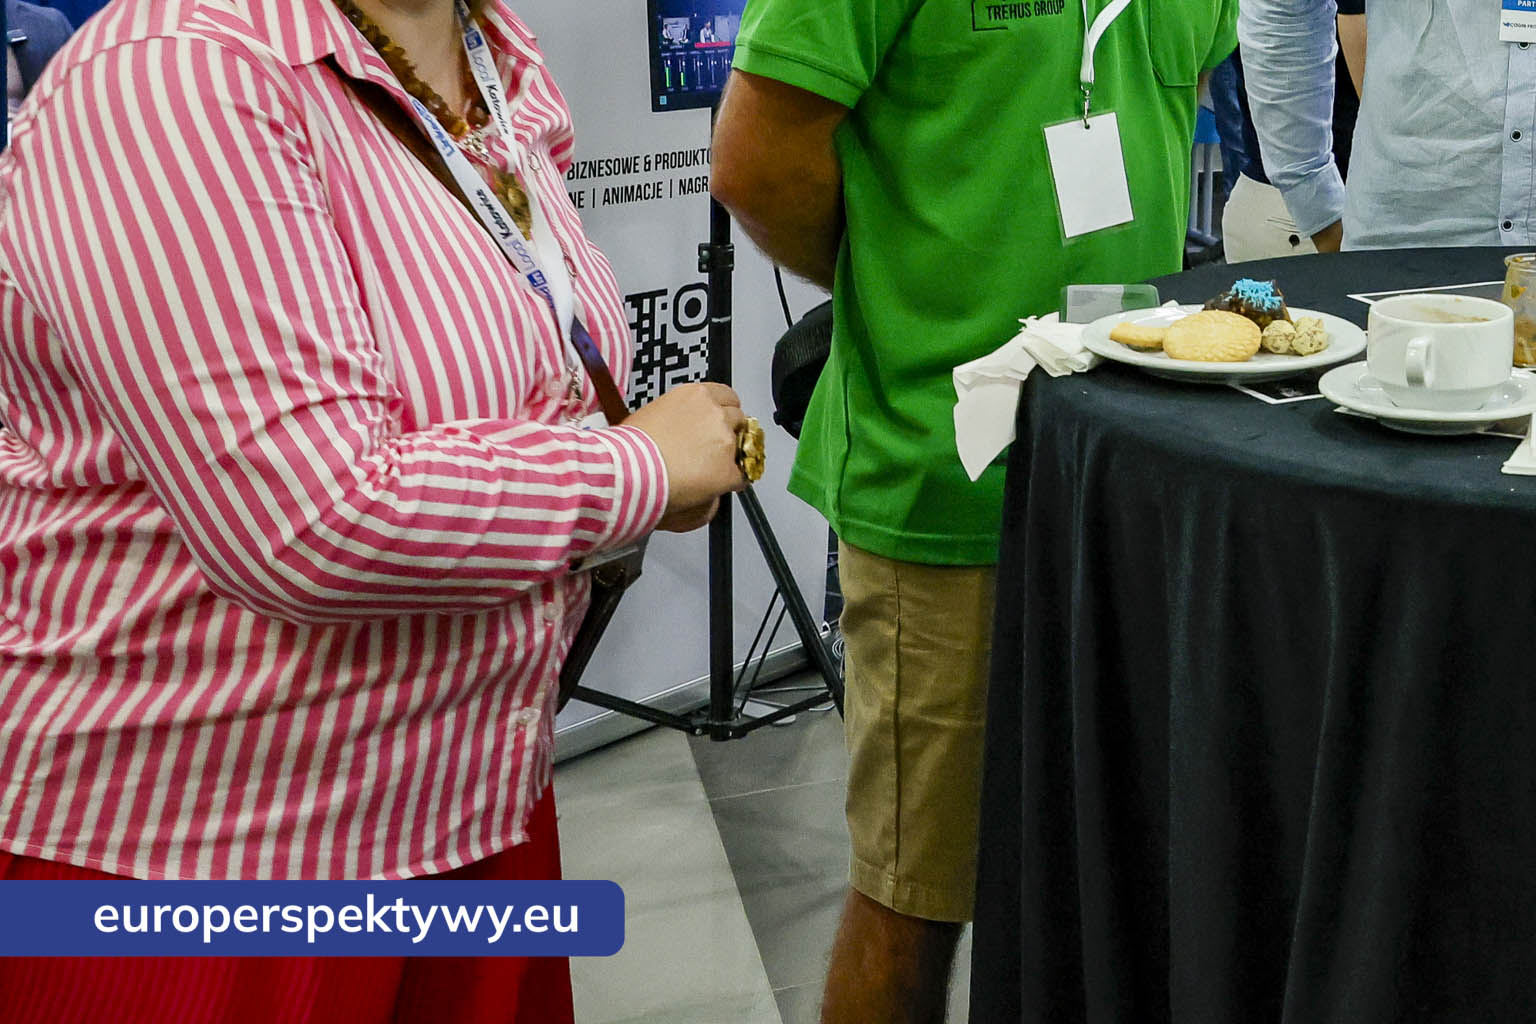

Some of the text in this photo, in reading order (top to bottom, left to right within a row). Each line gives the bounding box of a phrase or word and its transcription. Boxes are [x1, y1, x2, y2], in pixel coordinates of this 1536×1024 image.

[986, 2, 1032, 21] TREHUS
[567, 155, 641, 181] BIZNESOWE
[643, 154, 652, 172] &
[602, 181, 663, 206] ANIMACJE
